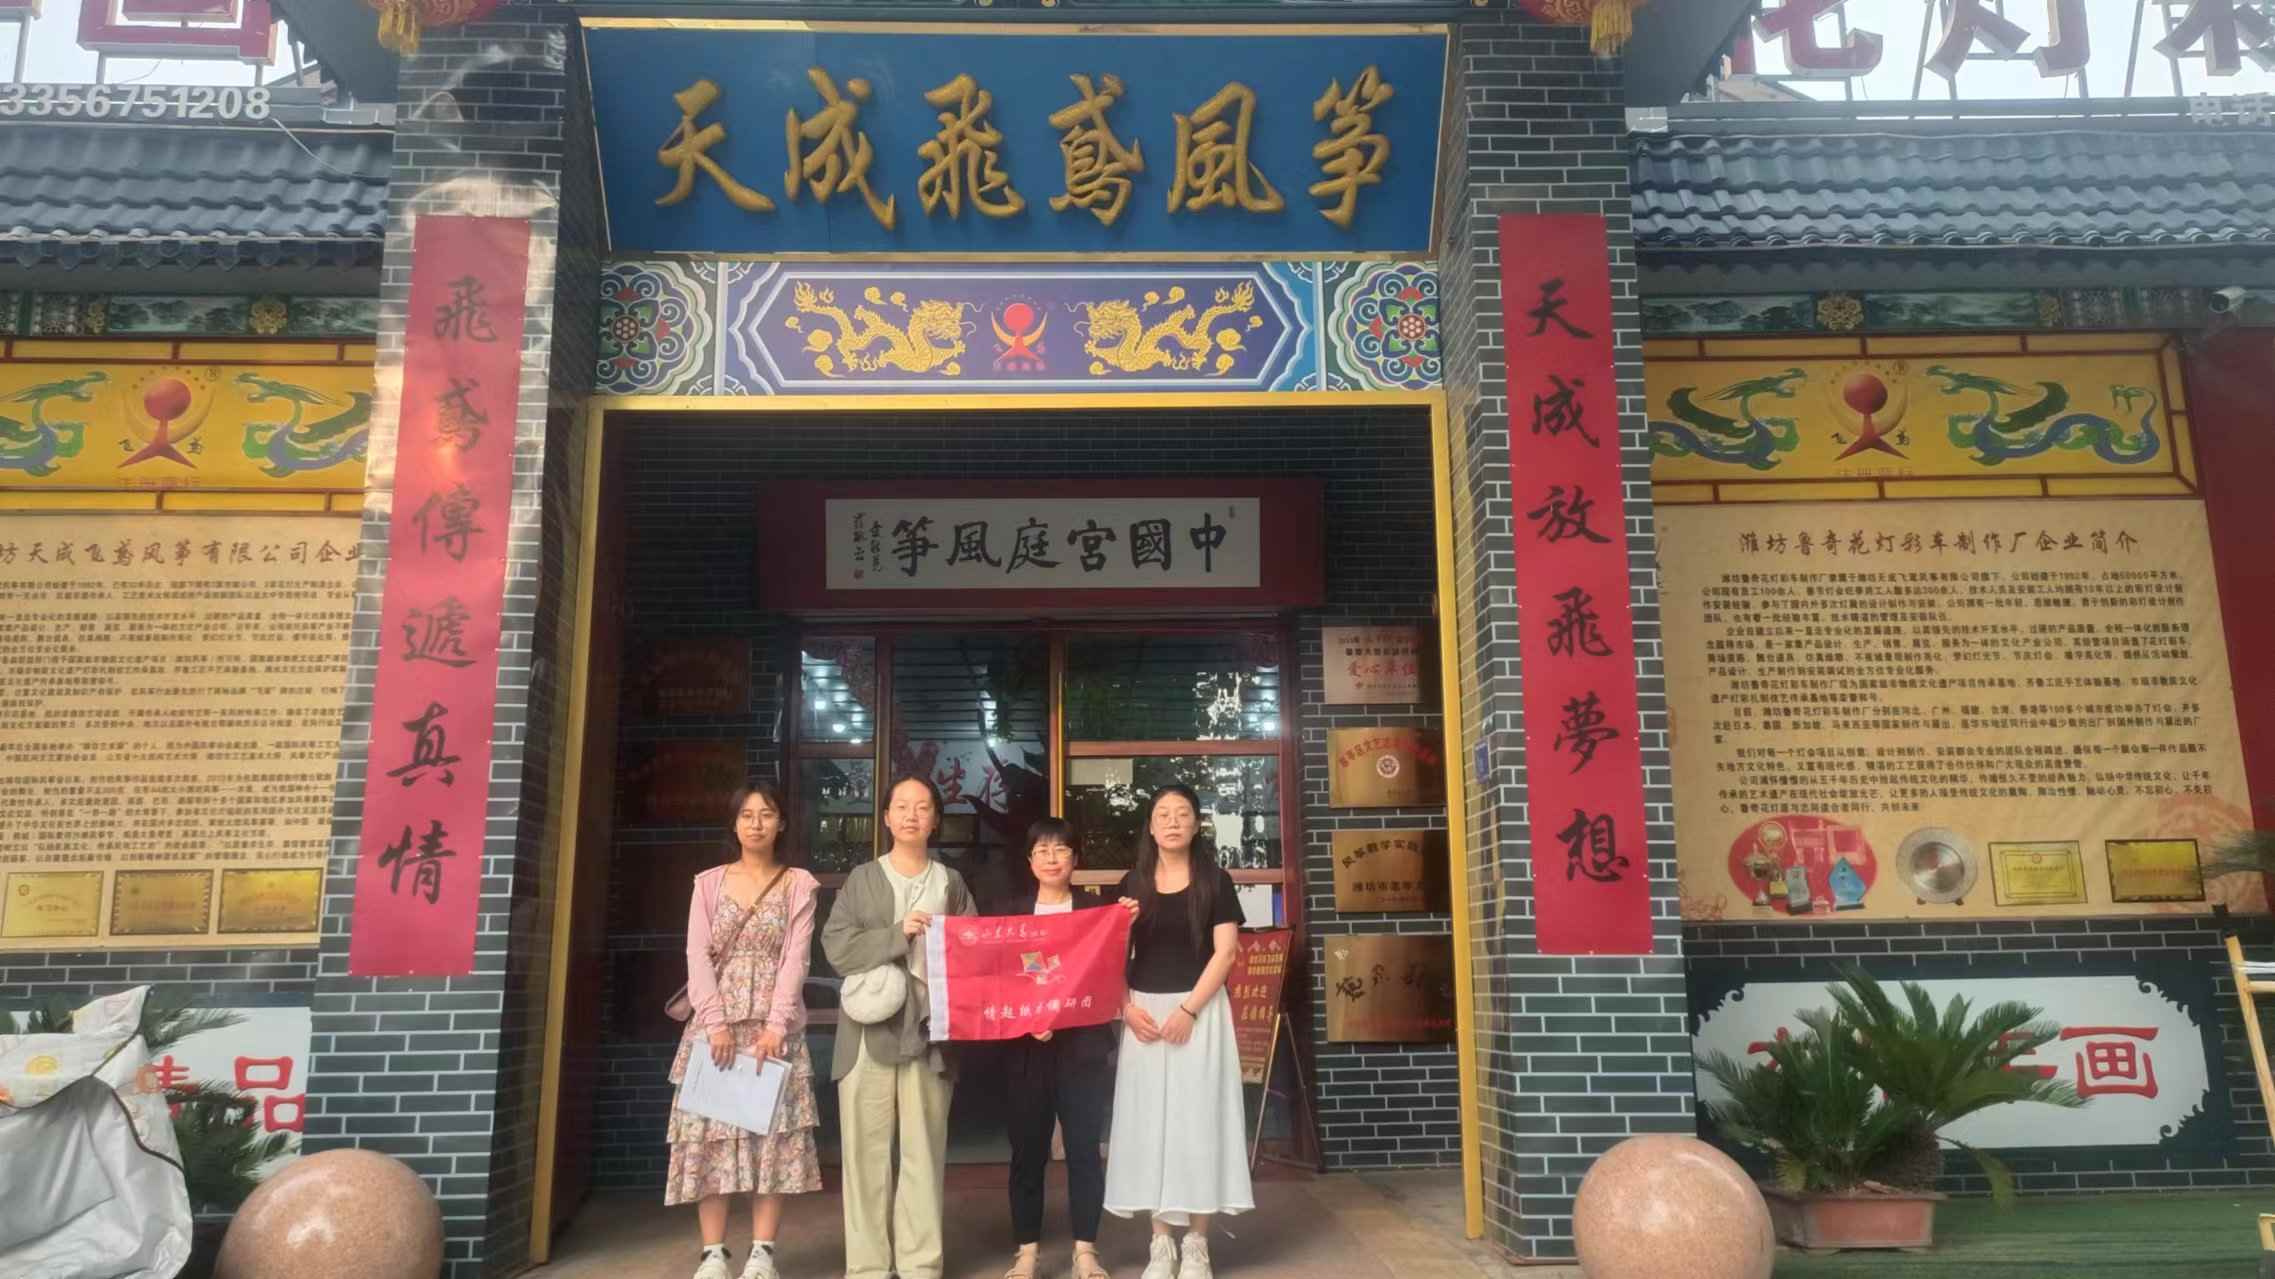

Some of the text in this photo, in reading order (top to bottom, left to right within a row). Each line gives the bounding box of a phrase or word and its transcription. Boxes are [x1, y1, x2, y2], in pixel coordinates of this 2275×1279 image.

[0, 84, 271, 119] 3356751208
[1738, 529, 2139, 556] 潍坊鲁奇花灯彩车制作厂企业简介
[1526, 276, 1630, 882] 天成放飛夢想
